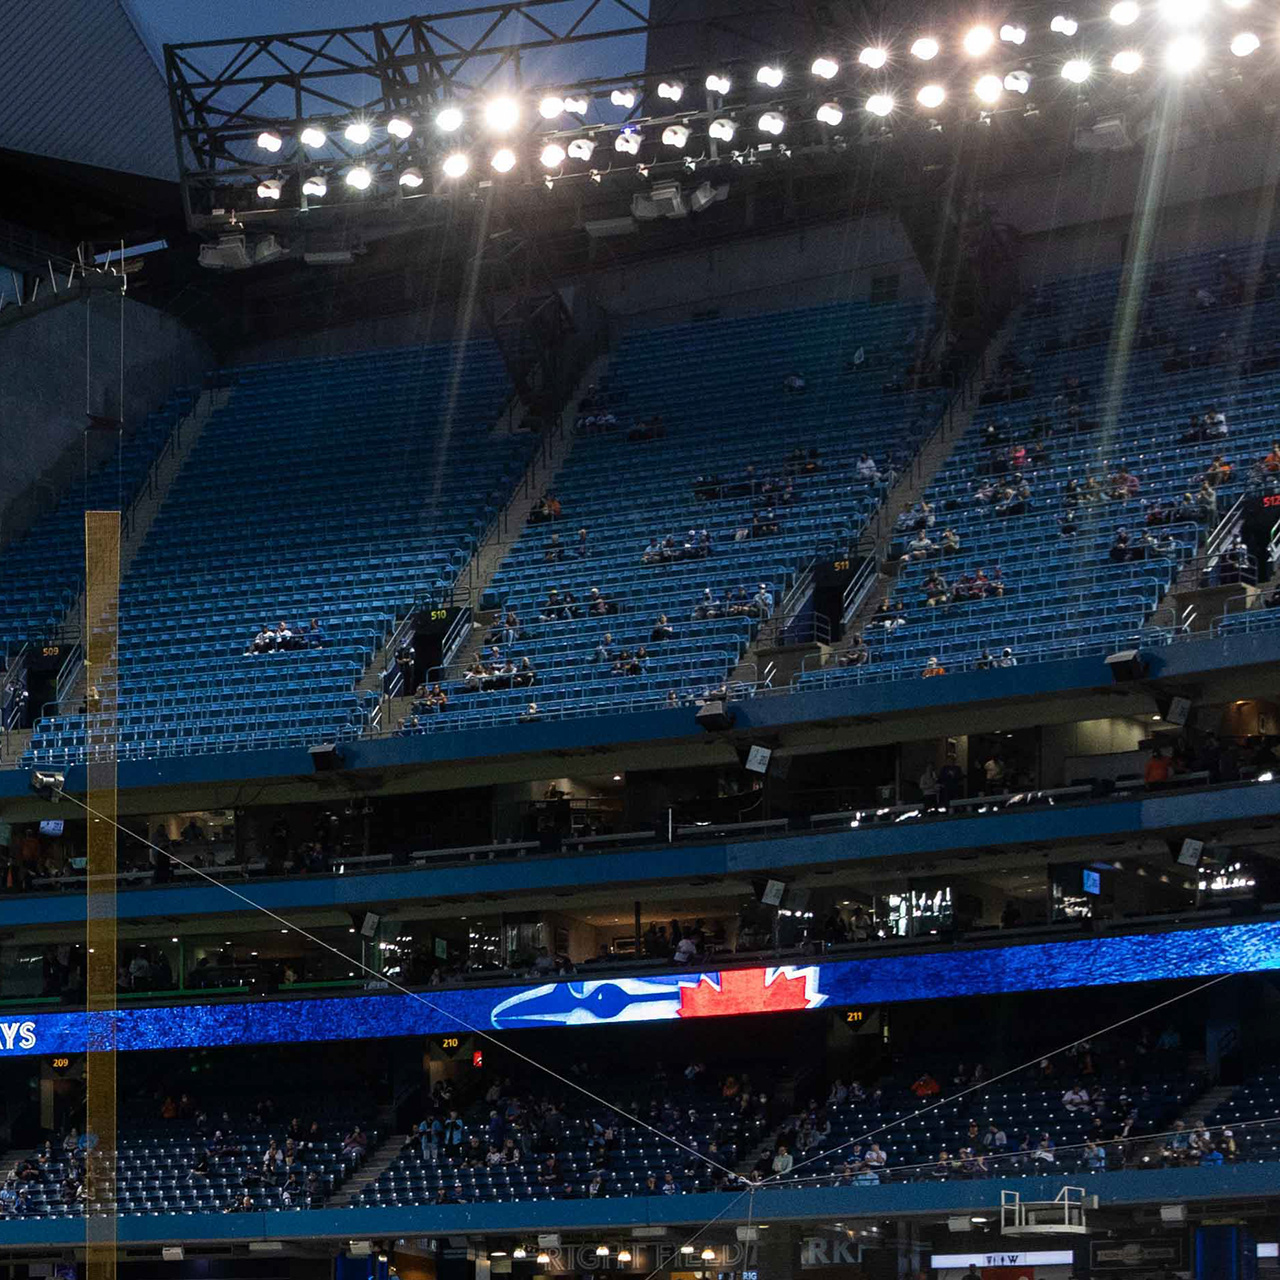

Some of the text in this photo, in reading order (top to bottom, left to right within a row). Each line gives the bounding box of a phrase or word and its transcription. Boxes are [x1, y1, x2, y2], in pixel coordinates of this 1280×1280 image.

[430, 610, 446, 620] 510
[42, 646, 60, 657] 509
[847, 1011, 863, 1022] 211
[442, 1038, 459, 1048] 210
[52, 1058, 69, 1068] 209
